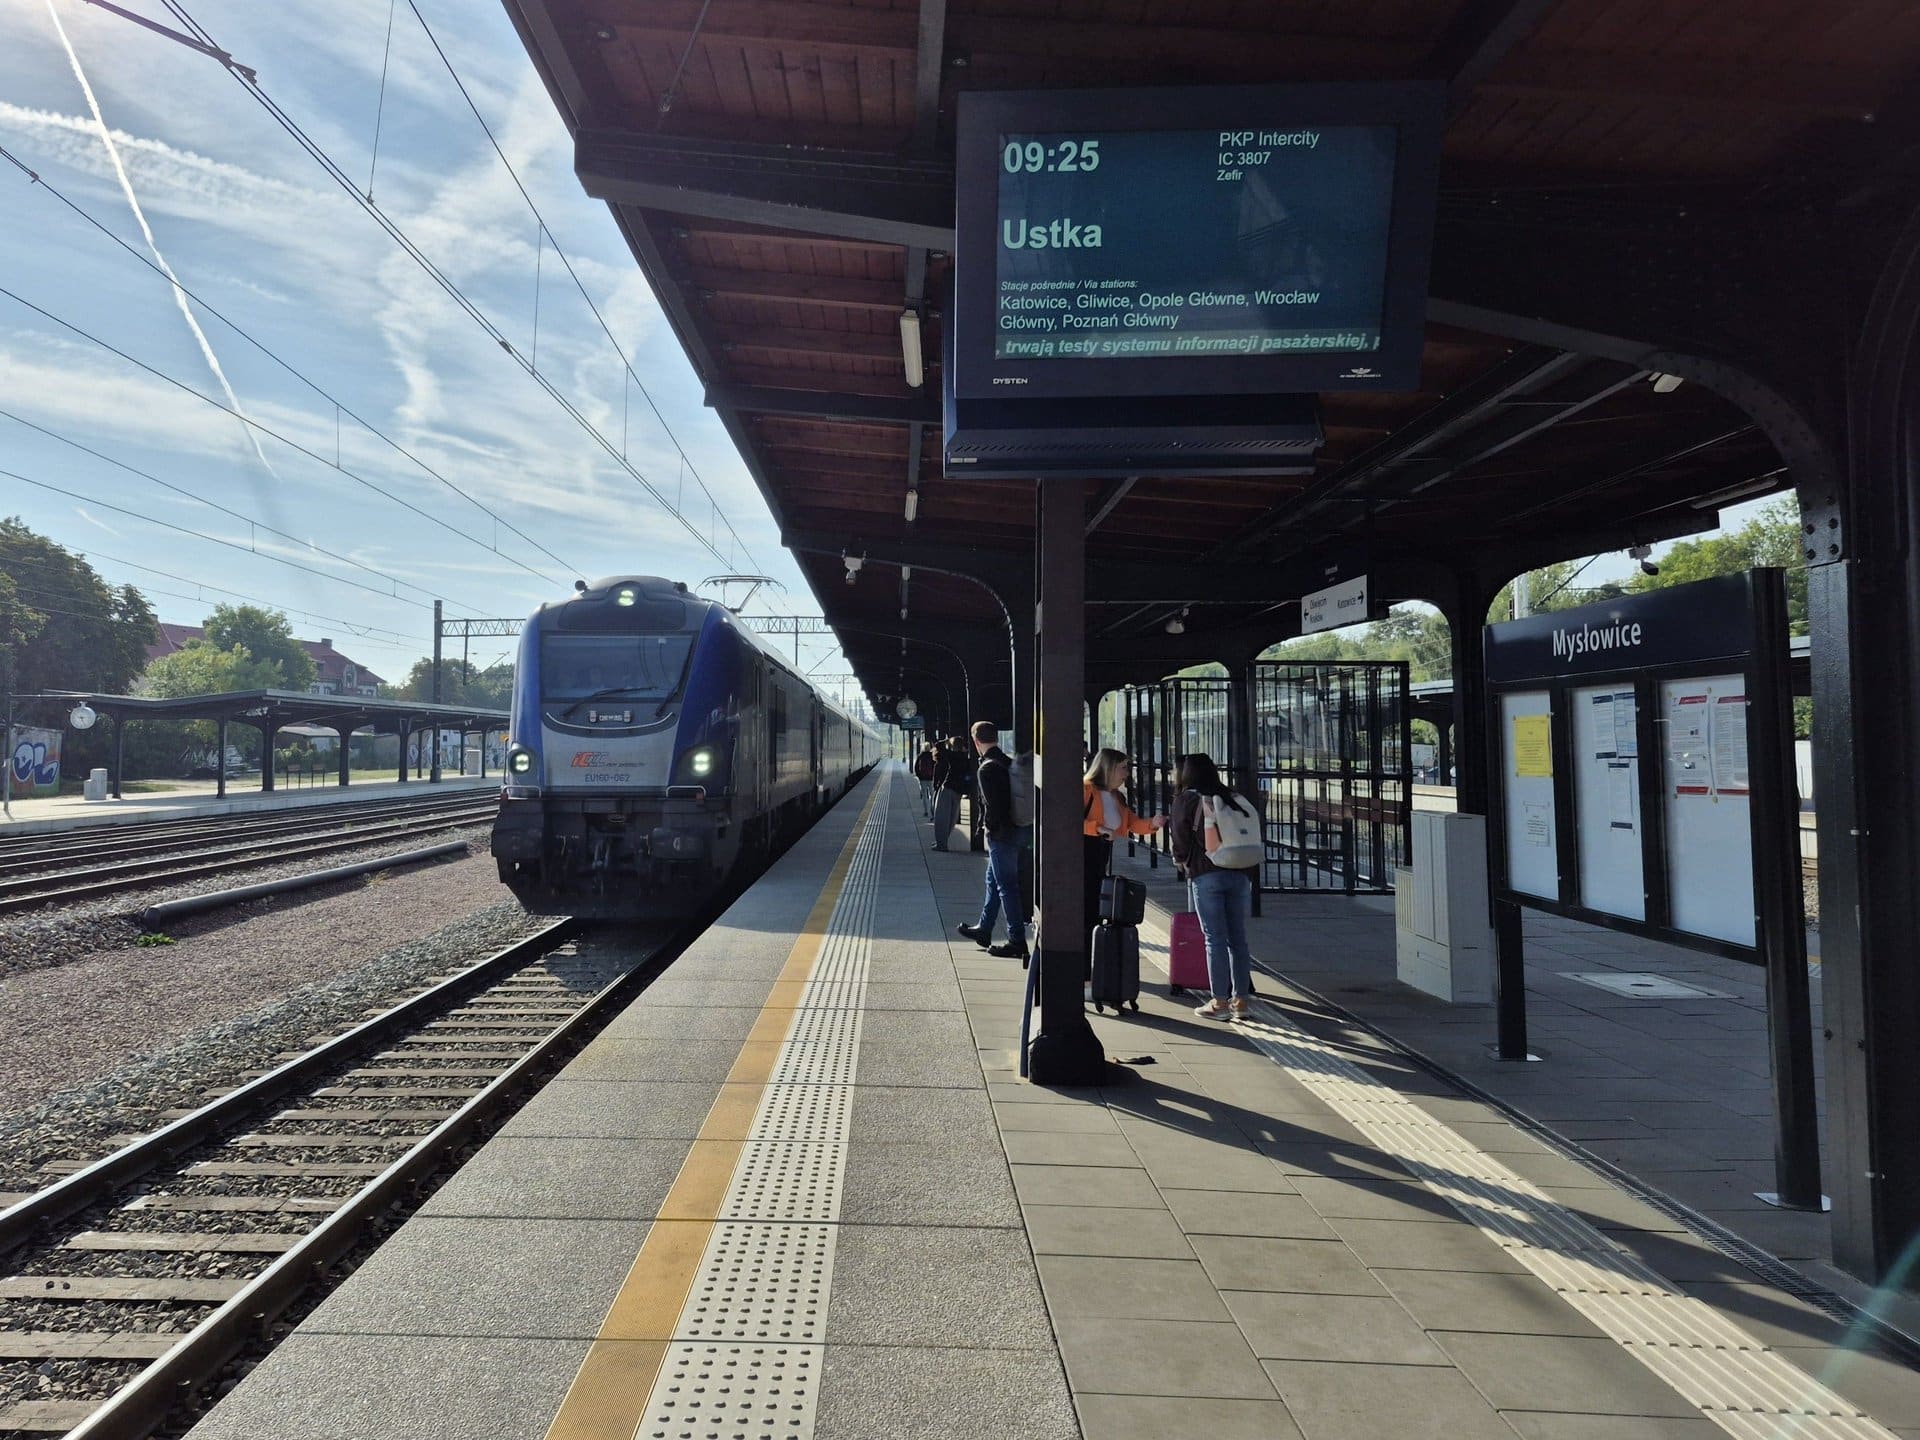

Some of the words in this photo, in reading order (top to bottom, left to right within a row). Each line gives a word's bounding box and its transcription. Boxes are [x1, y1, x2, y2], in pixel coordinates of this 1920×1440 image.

[1219, 132, 1254, 147] PKP
[1258, 130, 1320, 149] Intercity
[1003, 141, 1100, 173] 09:25
[1218, 152, 1234, 165] IC
[1237, 151, 1271, 165] 3807
[1217, 169, 1243, 181] Zefir
[1003, 218, 1102, 249] Ustka
[1001, 281, 1028, 292] Stacje
[1030, 280, 1076, 291] pośrednie
[1083, 279, 1098, 289] Via
[1100, 279, 1139, 289] stations:
[1000, 295, 1071, 311] Katowice,
[1076, 294, 1134, 309] Gliwice,
[1139, 292, 1184, 309] Opole
[1188, 290, 1250, 307] Główne,
[1255, 290, 1320, 304] Wrocław
[1000, 314, 1058, 331] Główny,
[1062, 313, 1119, 328] Poznań
[1123, 313, 1179, 329] Główny
[1005, 339, 1054, 356] trwają
[1058, 338, 1099, 355] testy
[1101, 338, 1171, 355] systemu
[1175, 335, 1260, 353] informacji
[1260, 333, 1369, 352] pasażerskiej,
[1553, 618, 1641, 662] Mysłowice
